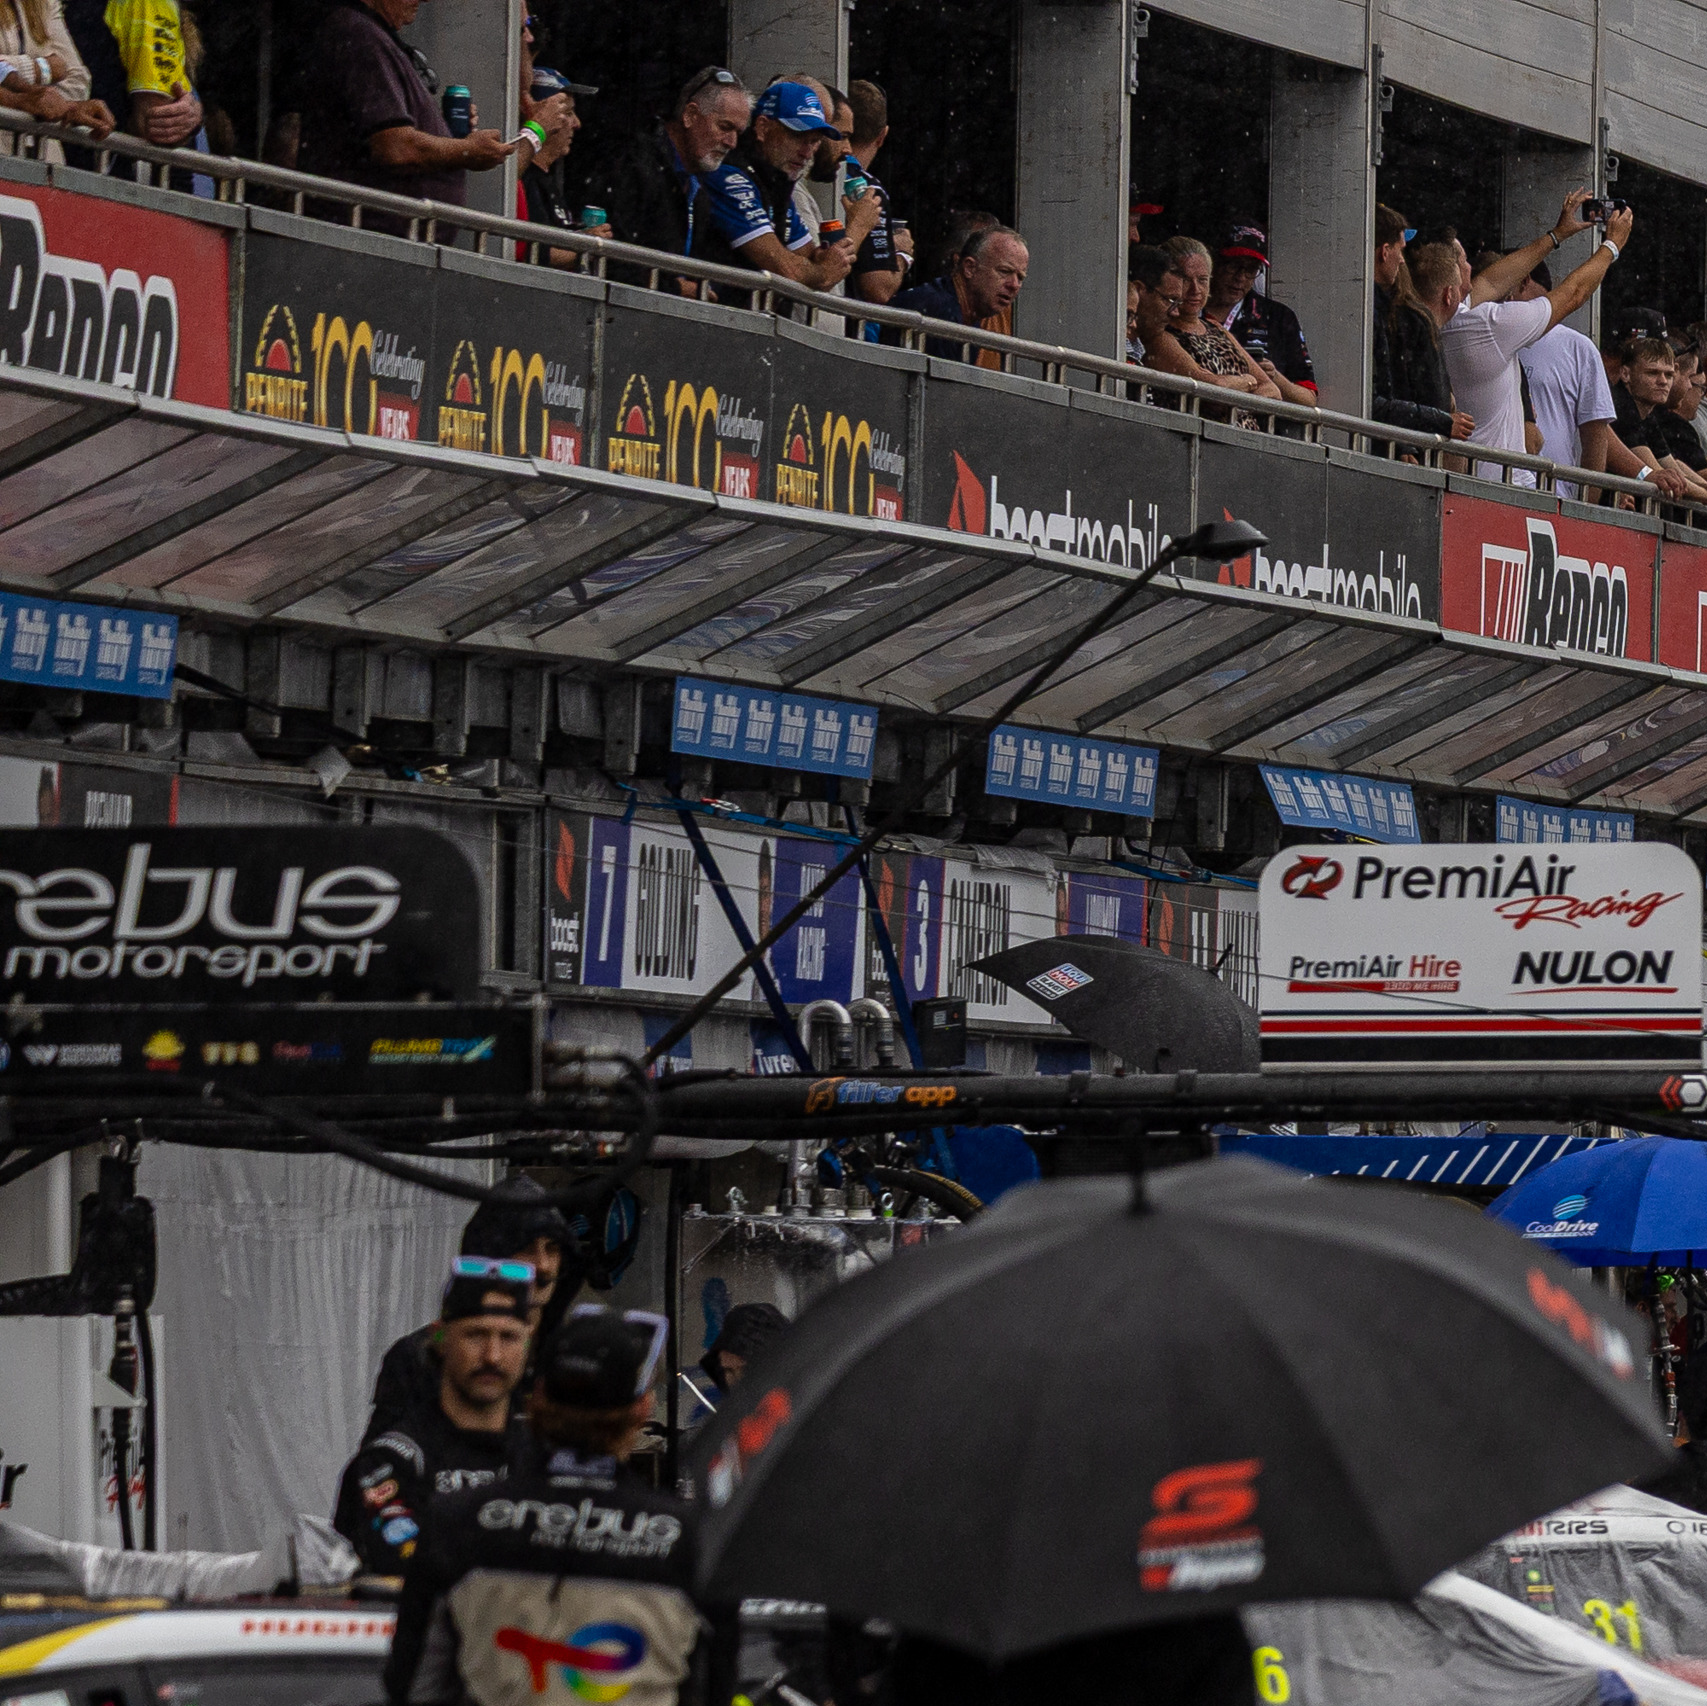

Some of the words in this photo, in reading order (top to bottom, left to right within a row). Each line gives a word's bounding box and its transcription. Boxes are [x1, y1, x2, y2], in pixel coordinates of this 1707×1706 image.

[1353, 854, 1577, 900] PremiAir
[1494, 889, 1684, 930] Racing
[914, 878, 929, 991] 3
[4, 940, 388, 987] motorsport
[1289, 956, 1403, 979] PremiAir
[1409, 955, 1462, 978] Hire
[1513, 950, 1674, 985] NULON
[1525, 1218, 1599, 1234] CoolDrive
[478, 1499, 681, 1541] erebus
[1544, 1520, 1610, 1537] RRS
[1583, 1600, 1643, 1655] 31
[1253, 1647, 1291, 1704] 6
